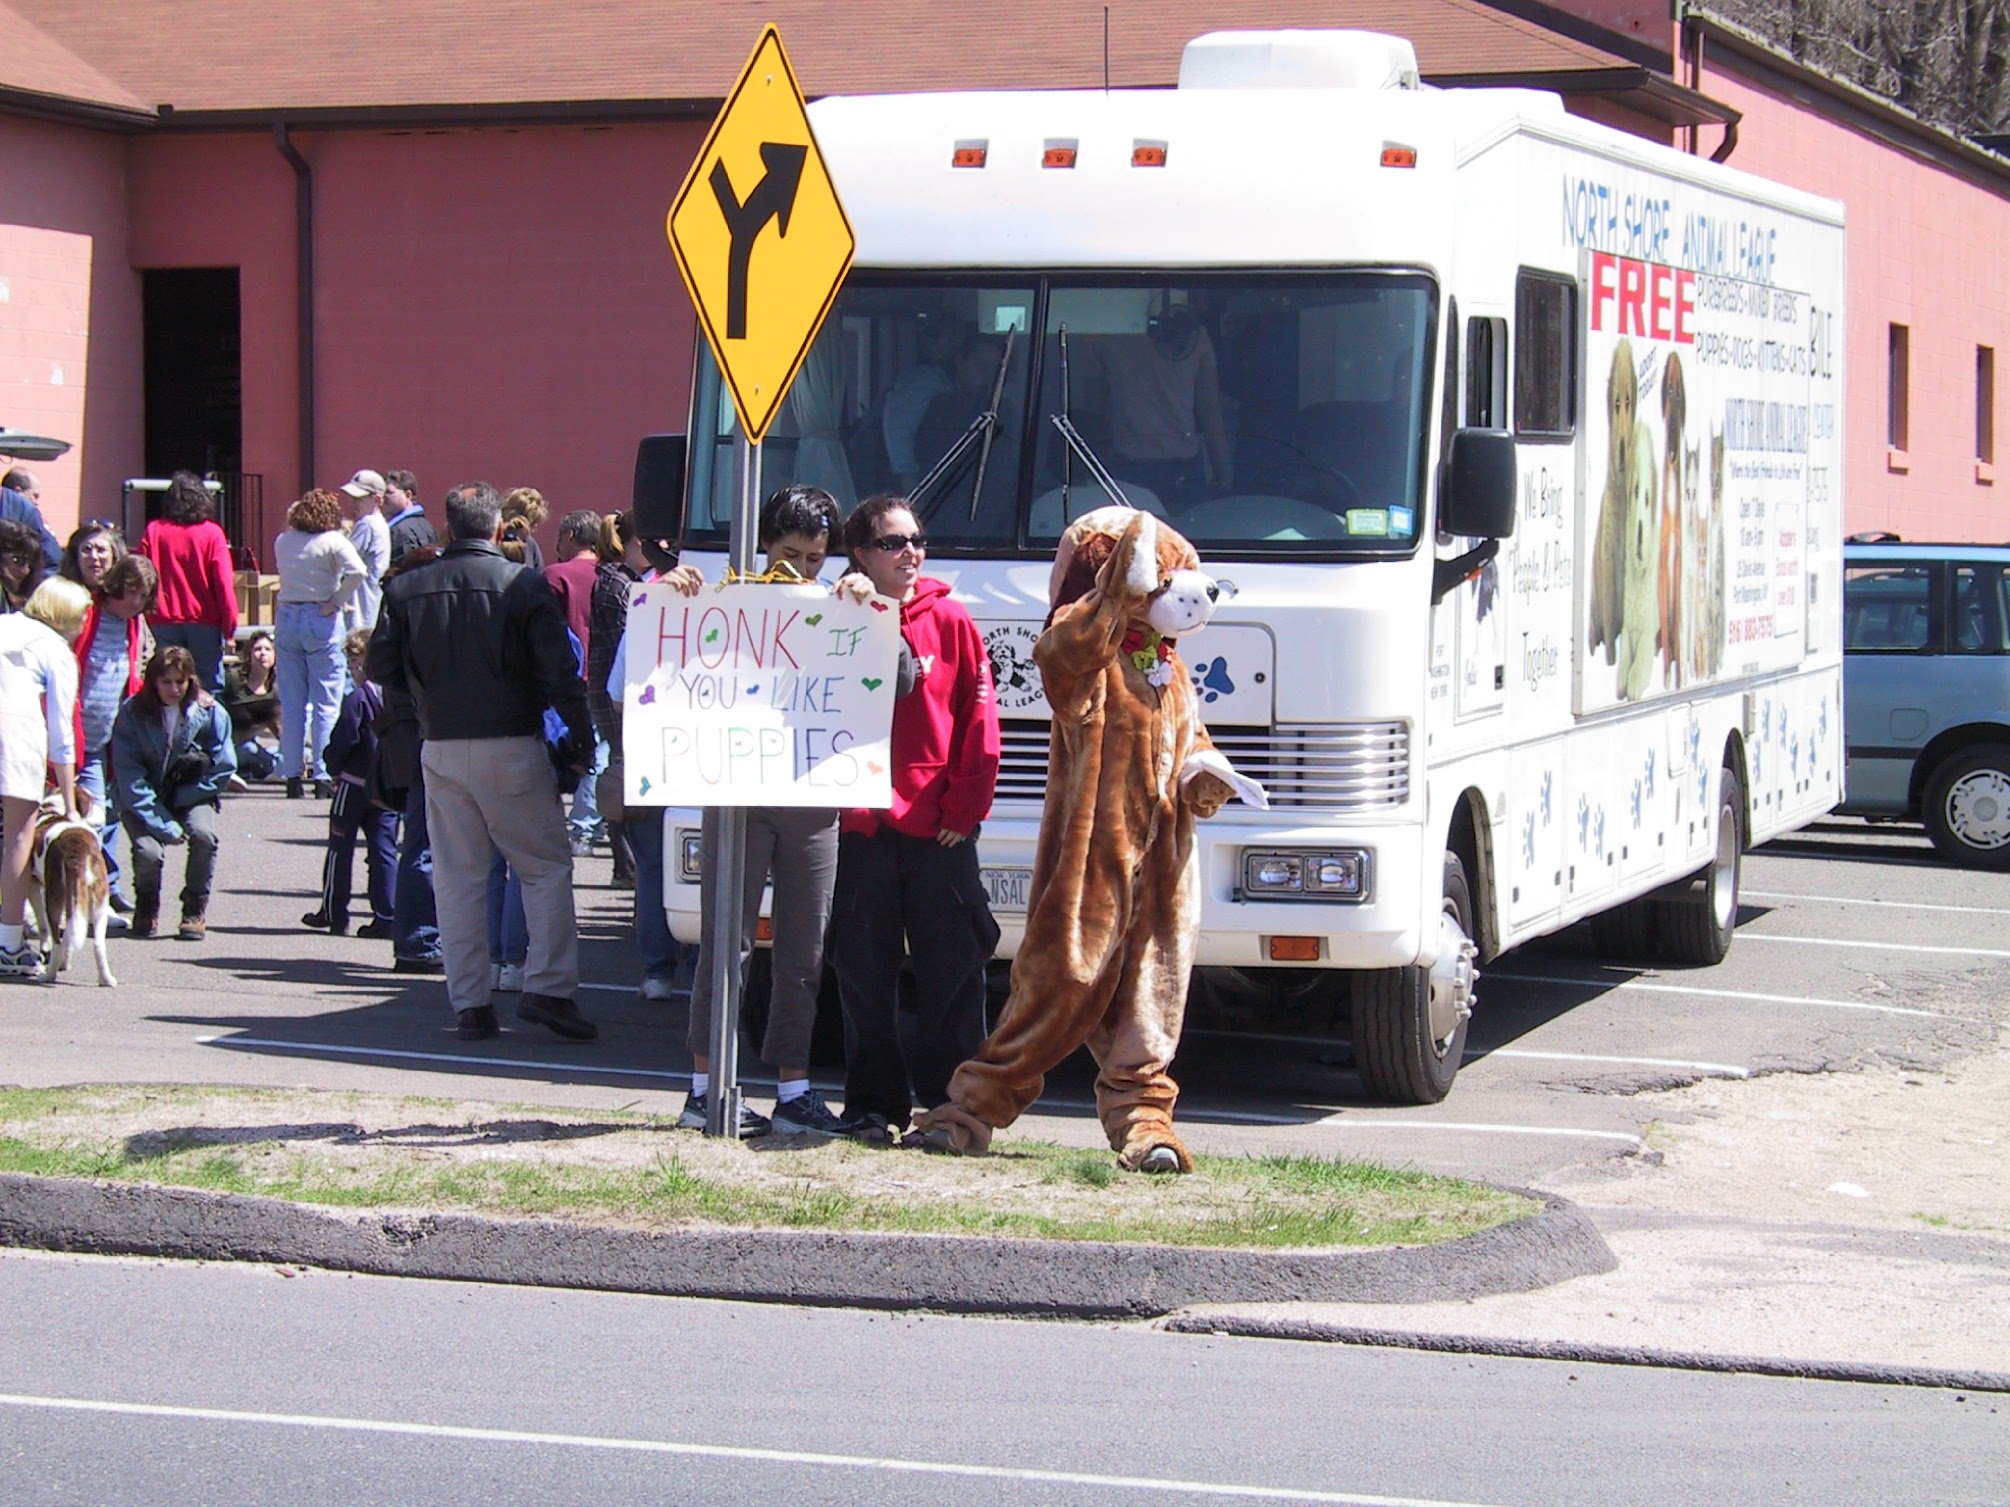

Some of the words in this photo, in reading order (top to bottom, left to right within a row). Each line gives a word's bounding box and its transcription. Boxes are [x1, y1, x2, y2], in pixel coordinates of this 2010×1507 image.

[1561, 172, 1618, 256] NORTH
[1623, 193, 1670, 263] SHORE
[1682, 211, 1727, 276] ANIMAL
[1732, 221, 1776, 286] LEAGUE
[1591, 249, 1696, 345] FREE
[1524, 469, 1538, 522] We
[1540, 465, 1564, 530] Bring
[1509, 542, 1540, 606] People
[1554, 538, 1572, 592] Pets
[656, 606, 801, 670] HONK
[826, 625, 868, 657] IF
[982, 626, 1010, 646] ORTH
[1016, 626, 1039, 643] SHO
[1522, 630, 1560, 693] Together
[679, 673, 738, 710] YOU
[770, 676, 846, 713] LIKE
[1015, 686, 1045, 708] LEAG
[661, 725, 859, 787] PUPPIES
[991, 879, 1026, 905] NSAL
